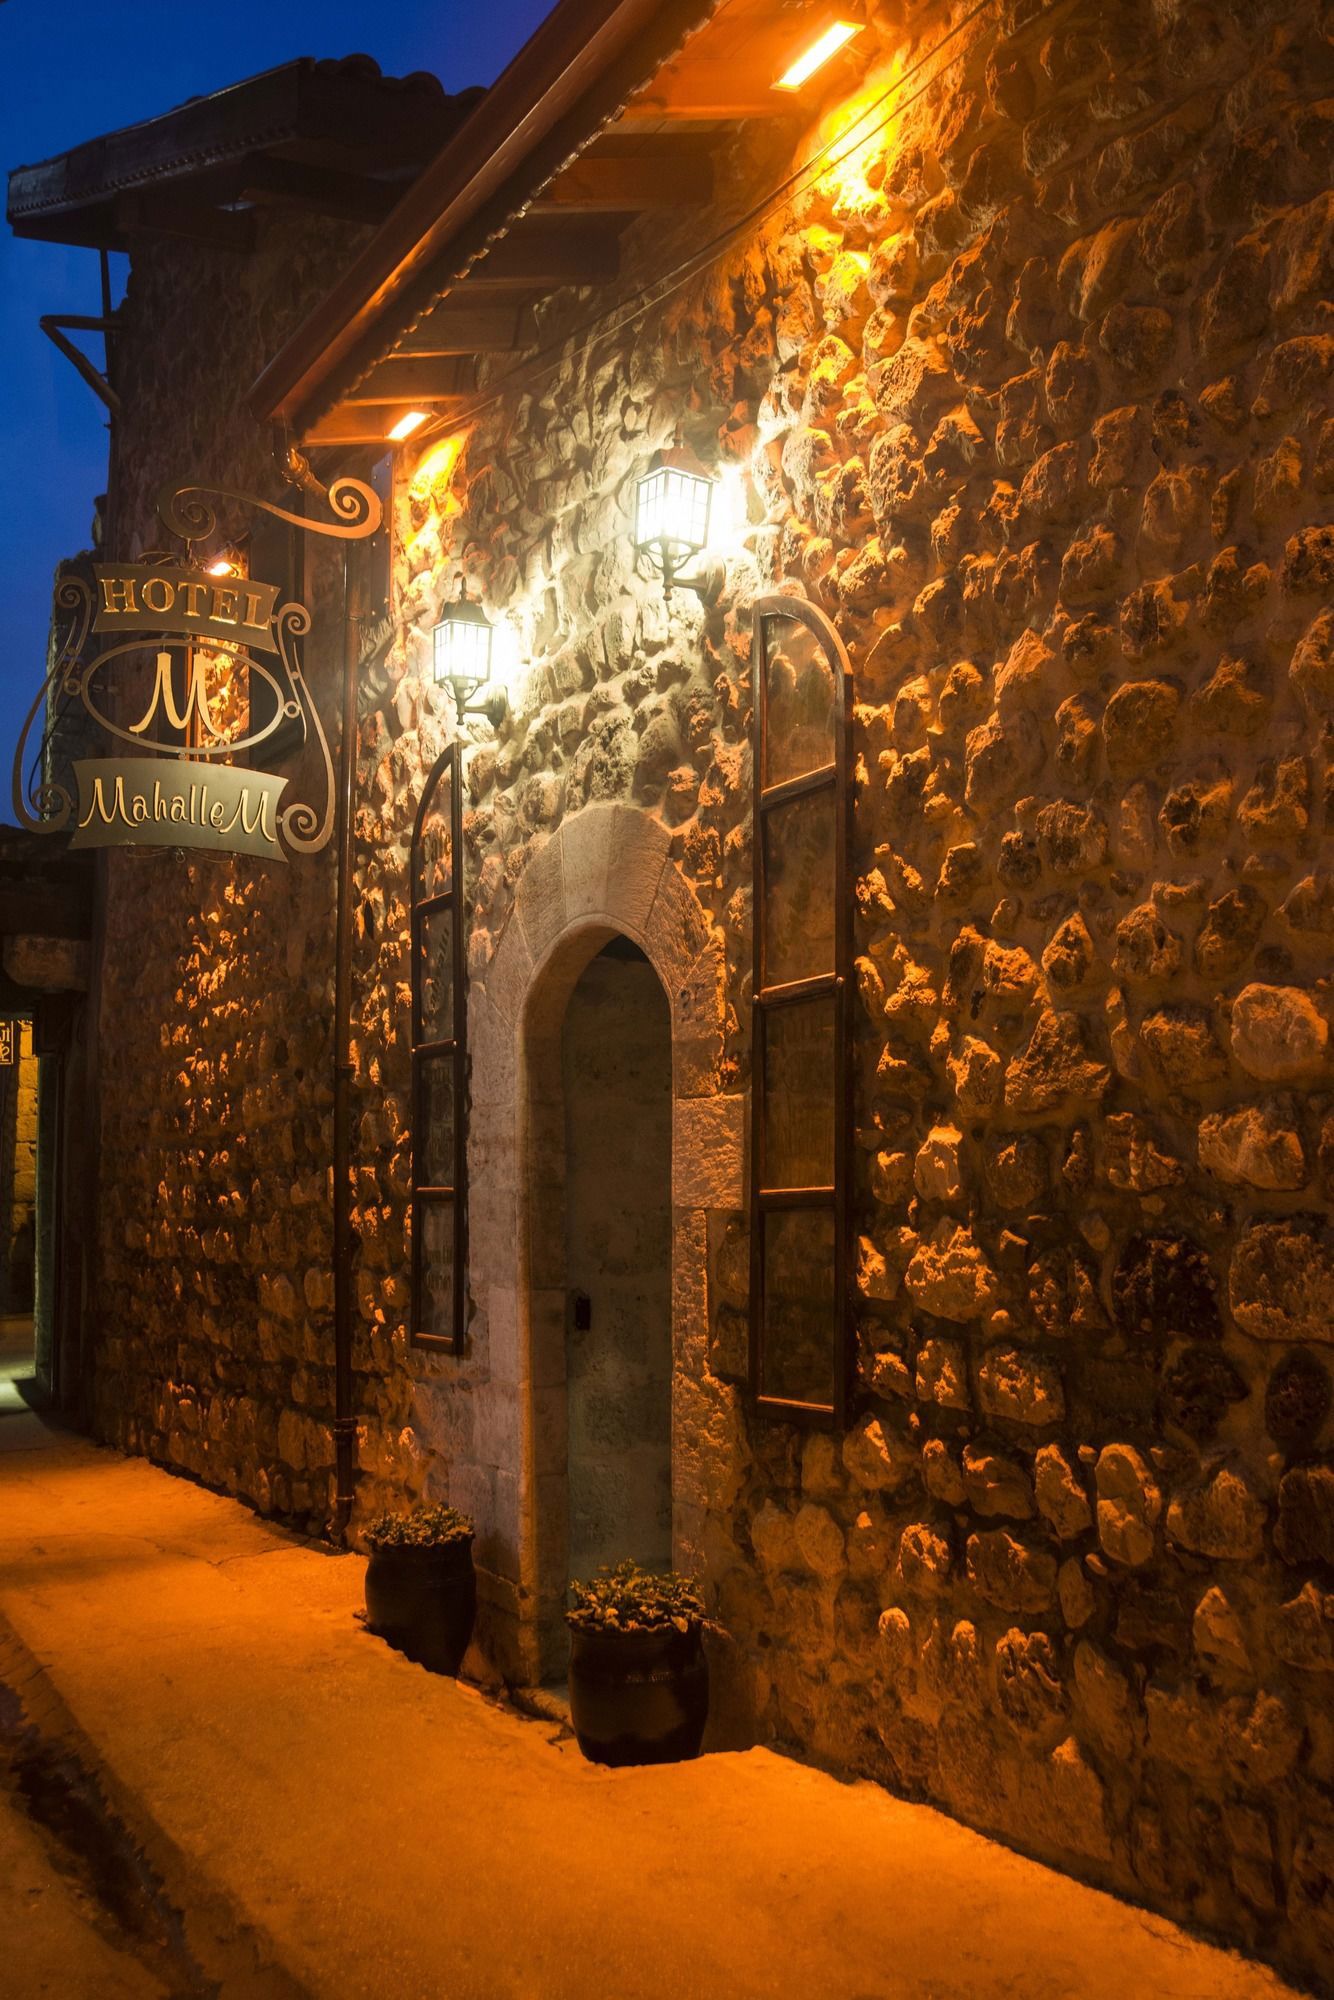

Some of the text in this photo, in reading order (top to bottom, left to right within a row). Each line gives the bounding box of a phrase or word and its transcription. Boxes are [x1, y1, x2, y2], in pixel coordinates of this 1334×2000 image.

[100, 577, 271, 630] HOTEL
[129, 652, 231, 740] M
[79, 776, 276, 842] MahalleM
